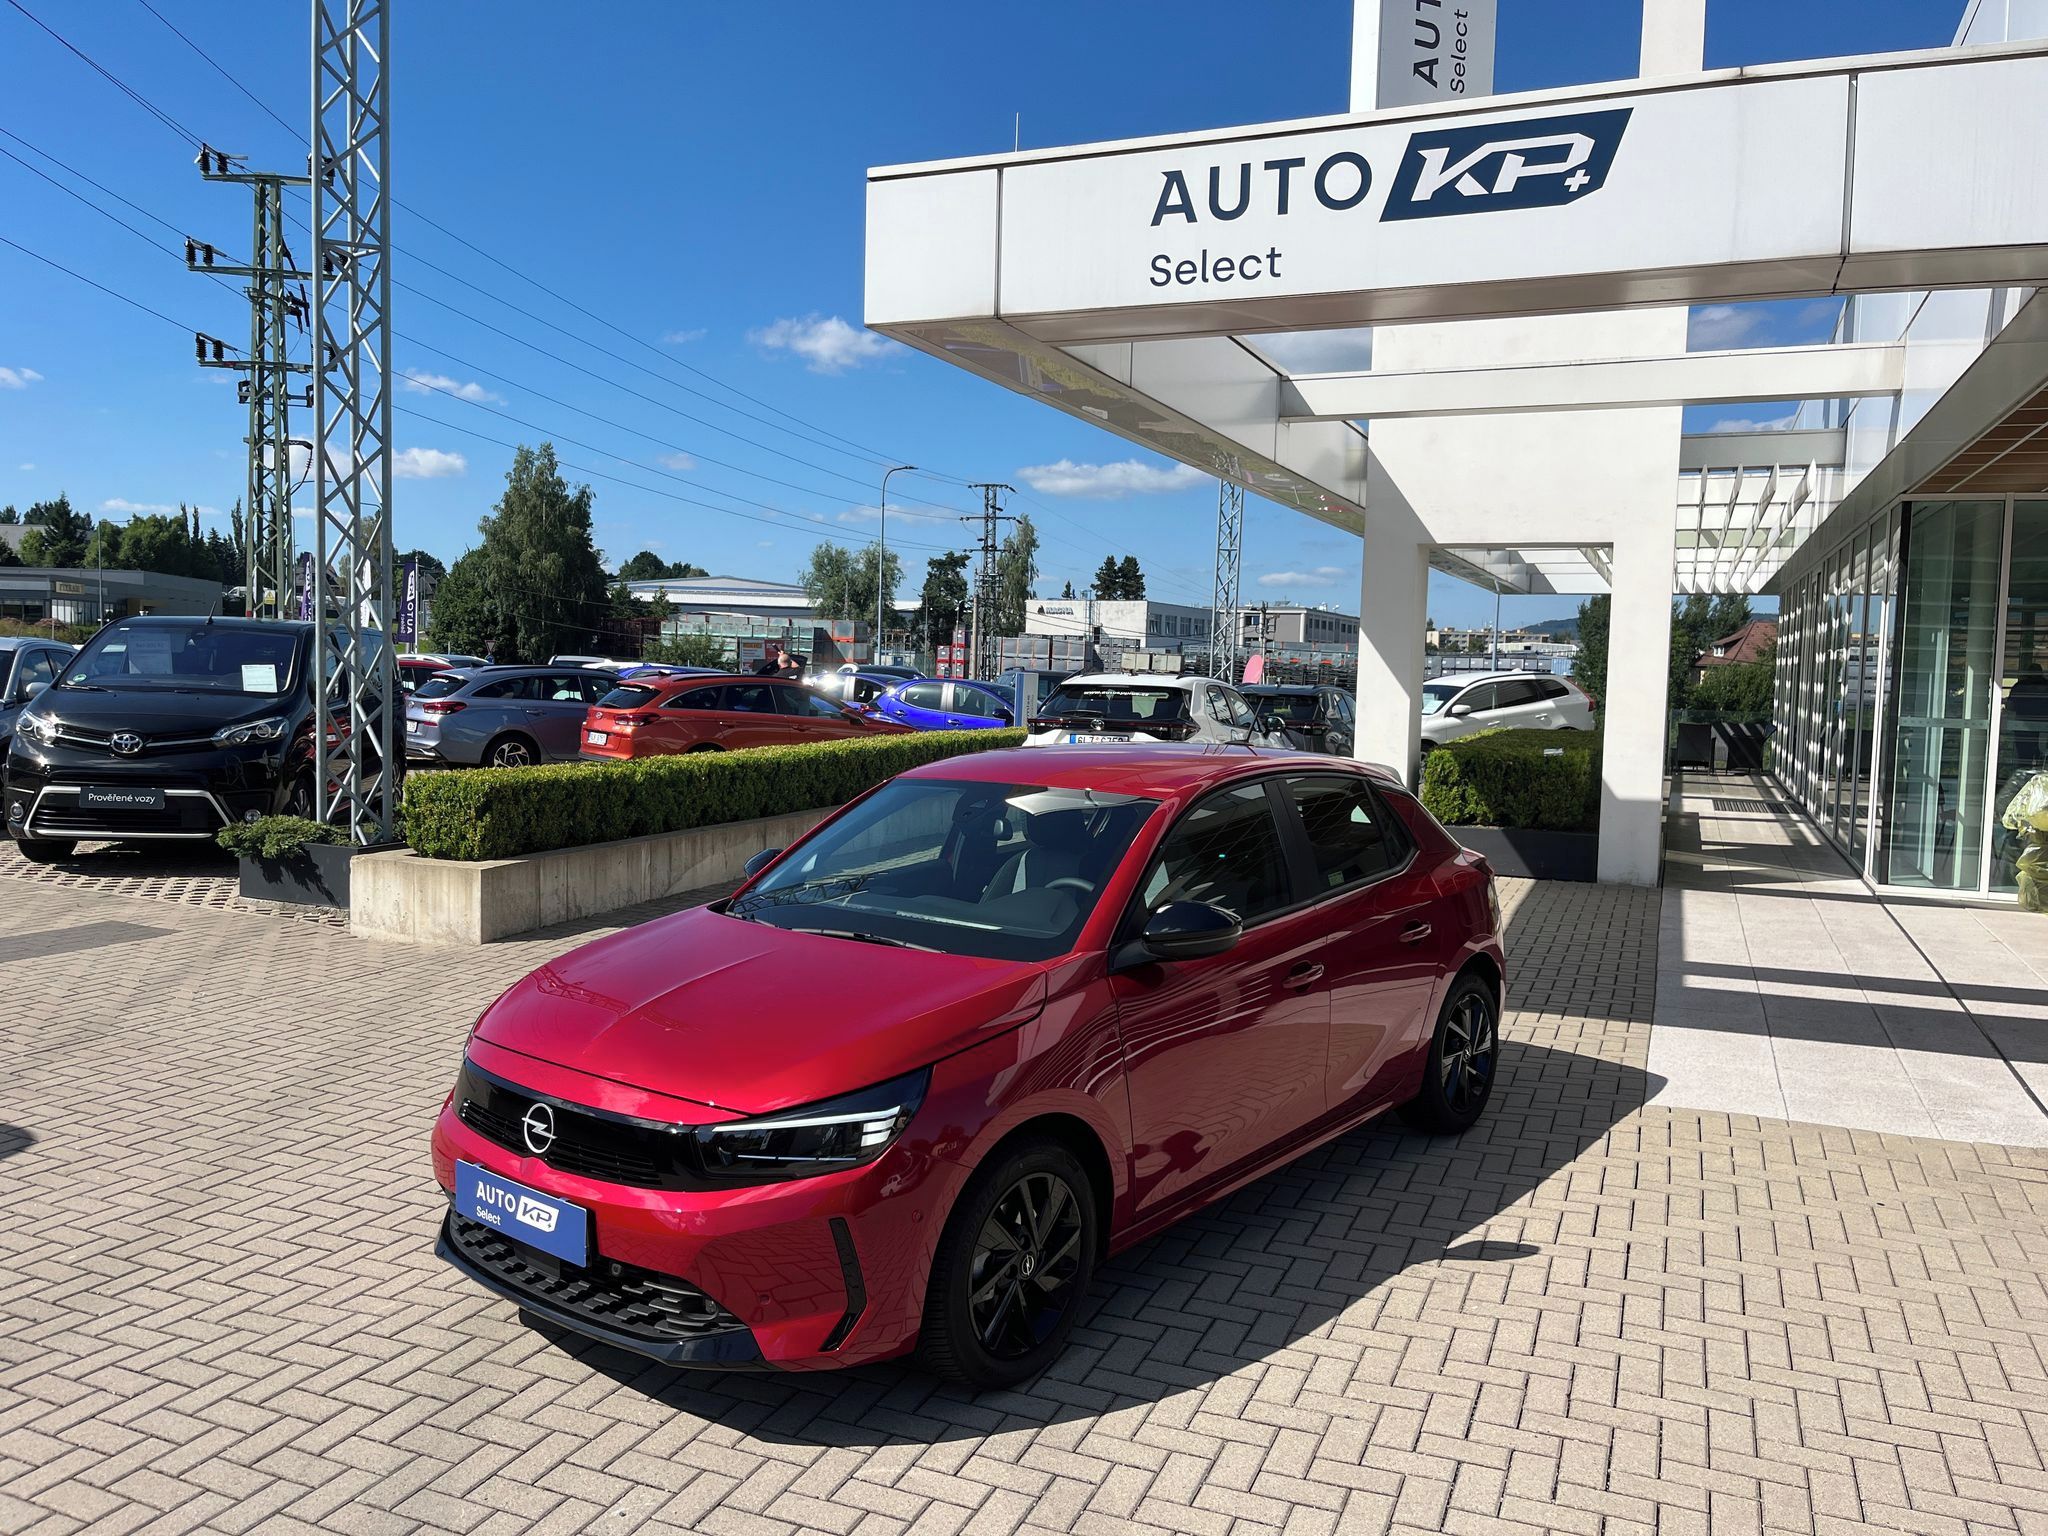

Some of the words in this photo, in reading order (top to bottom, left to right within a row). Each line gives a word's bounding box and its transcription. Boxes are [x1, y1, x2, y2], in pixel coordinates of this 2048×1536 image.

[1450, 8, 1469, 94] Select
[1150, 151, 1373, 226] AUTO
[1149, 246, 1282, 287] Select
[88, 793, 133, 803] Prověřené
[134, 796, 156, 805] vozy
[476, 1181, 516, 1213] AUTO
[476, 1205, 502, 1226] Select
